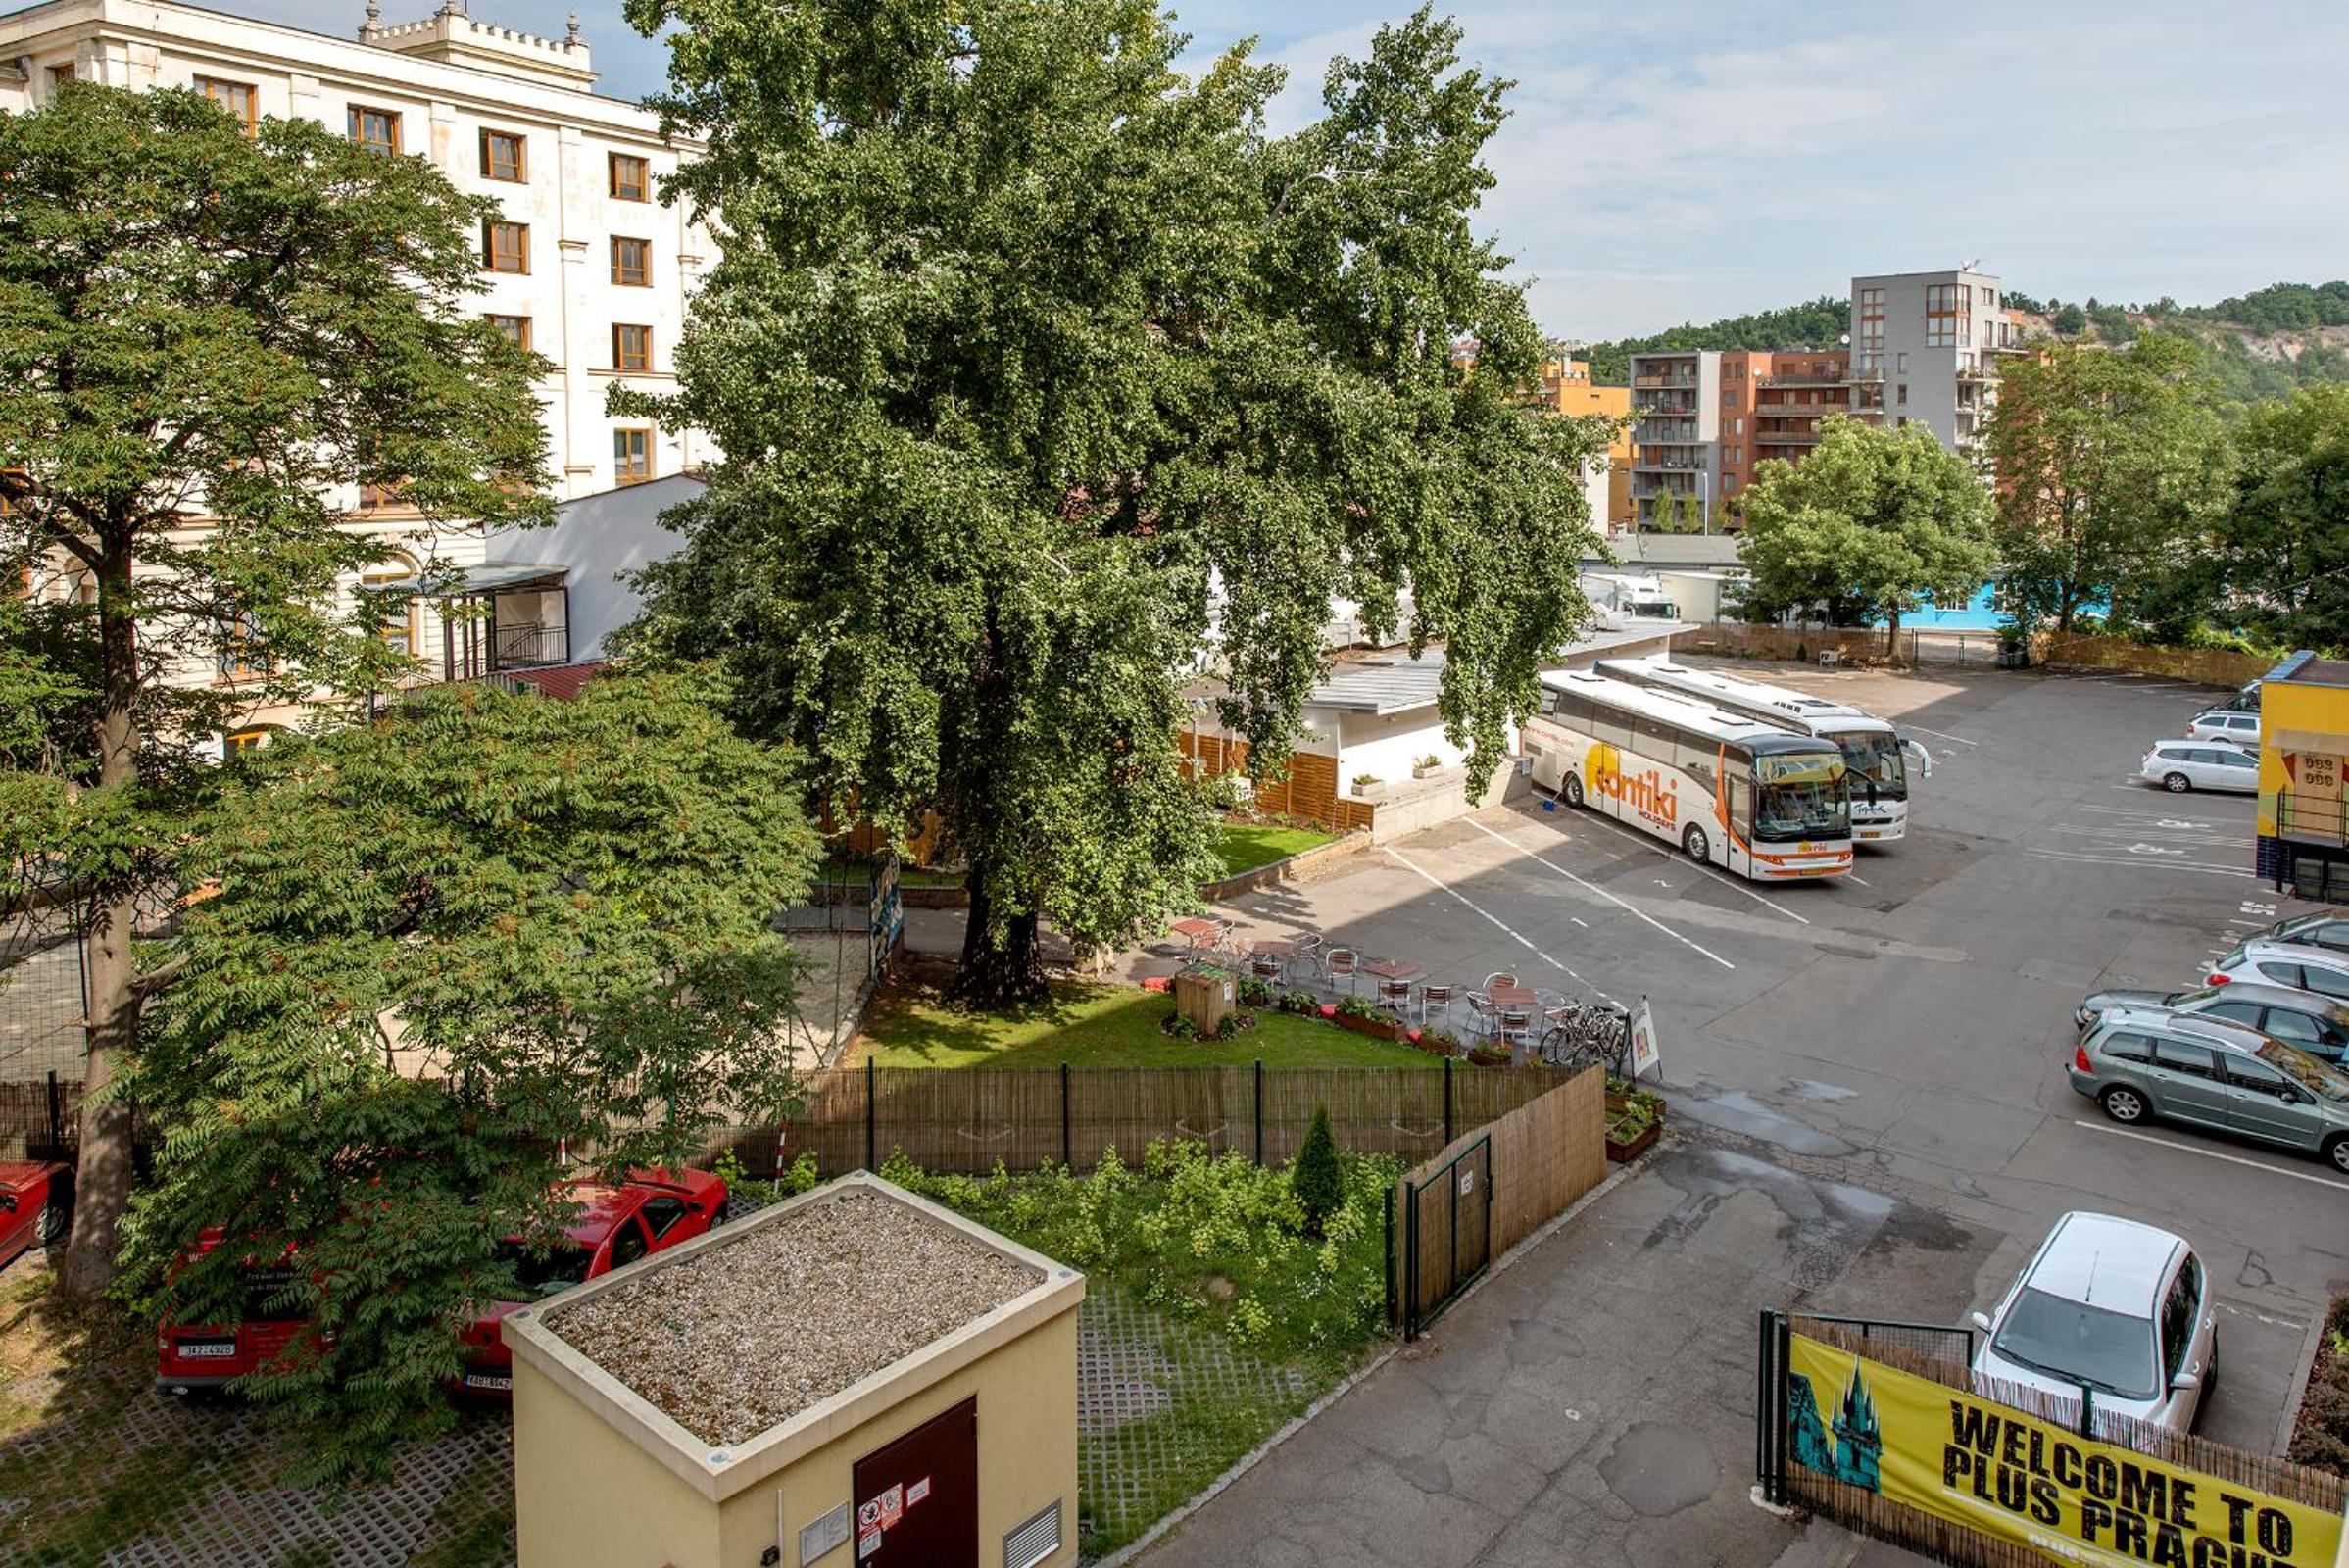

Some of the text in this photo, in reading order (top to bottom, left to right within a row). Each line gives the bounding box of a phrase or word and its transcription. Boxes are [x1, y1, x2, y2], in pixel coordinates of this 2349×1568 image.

[1594, 769, 1678, 822] contiki
[1942, 1443, 2061, 1526] PLUS
[1950, 1399, 2294, 1558] WELCOME TO
